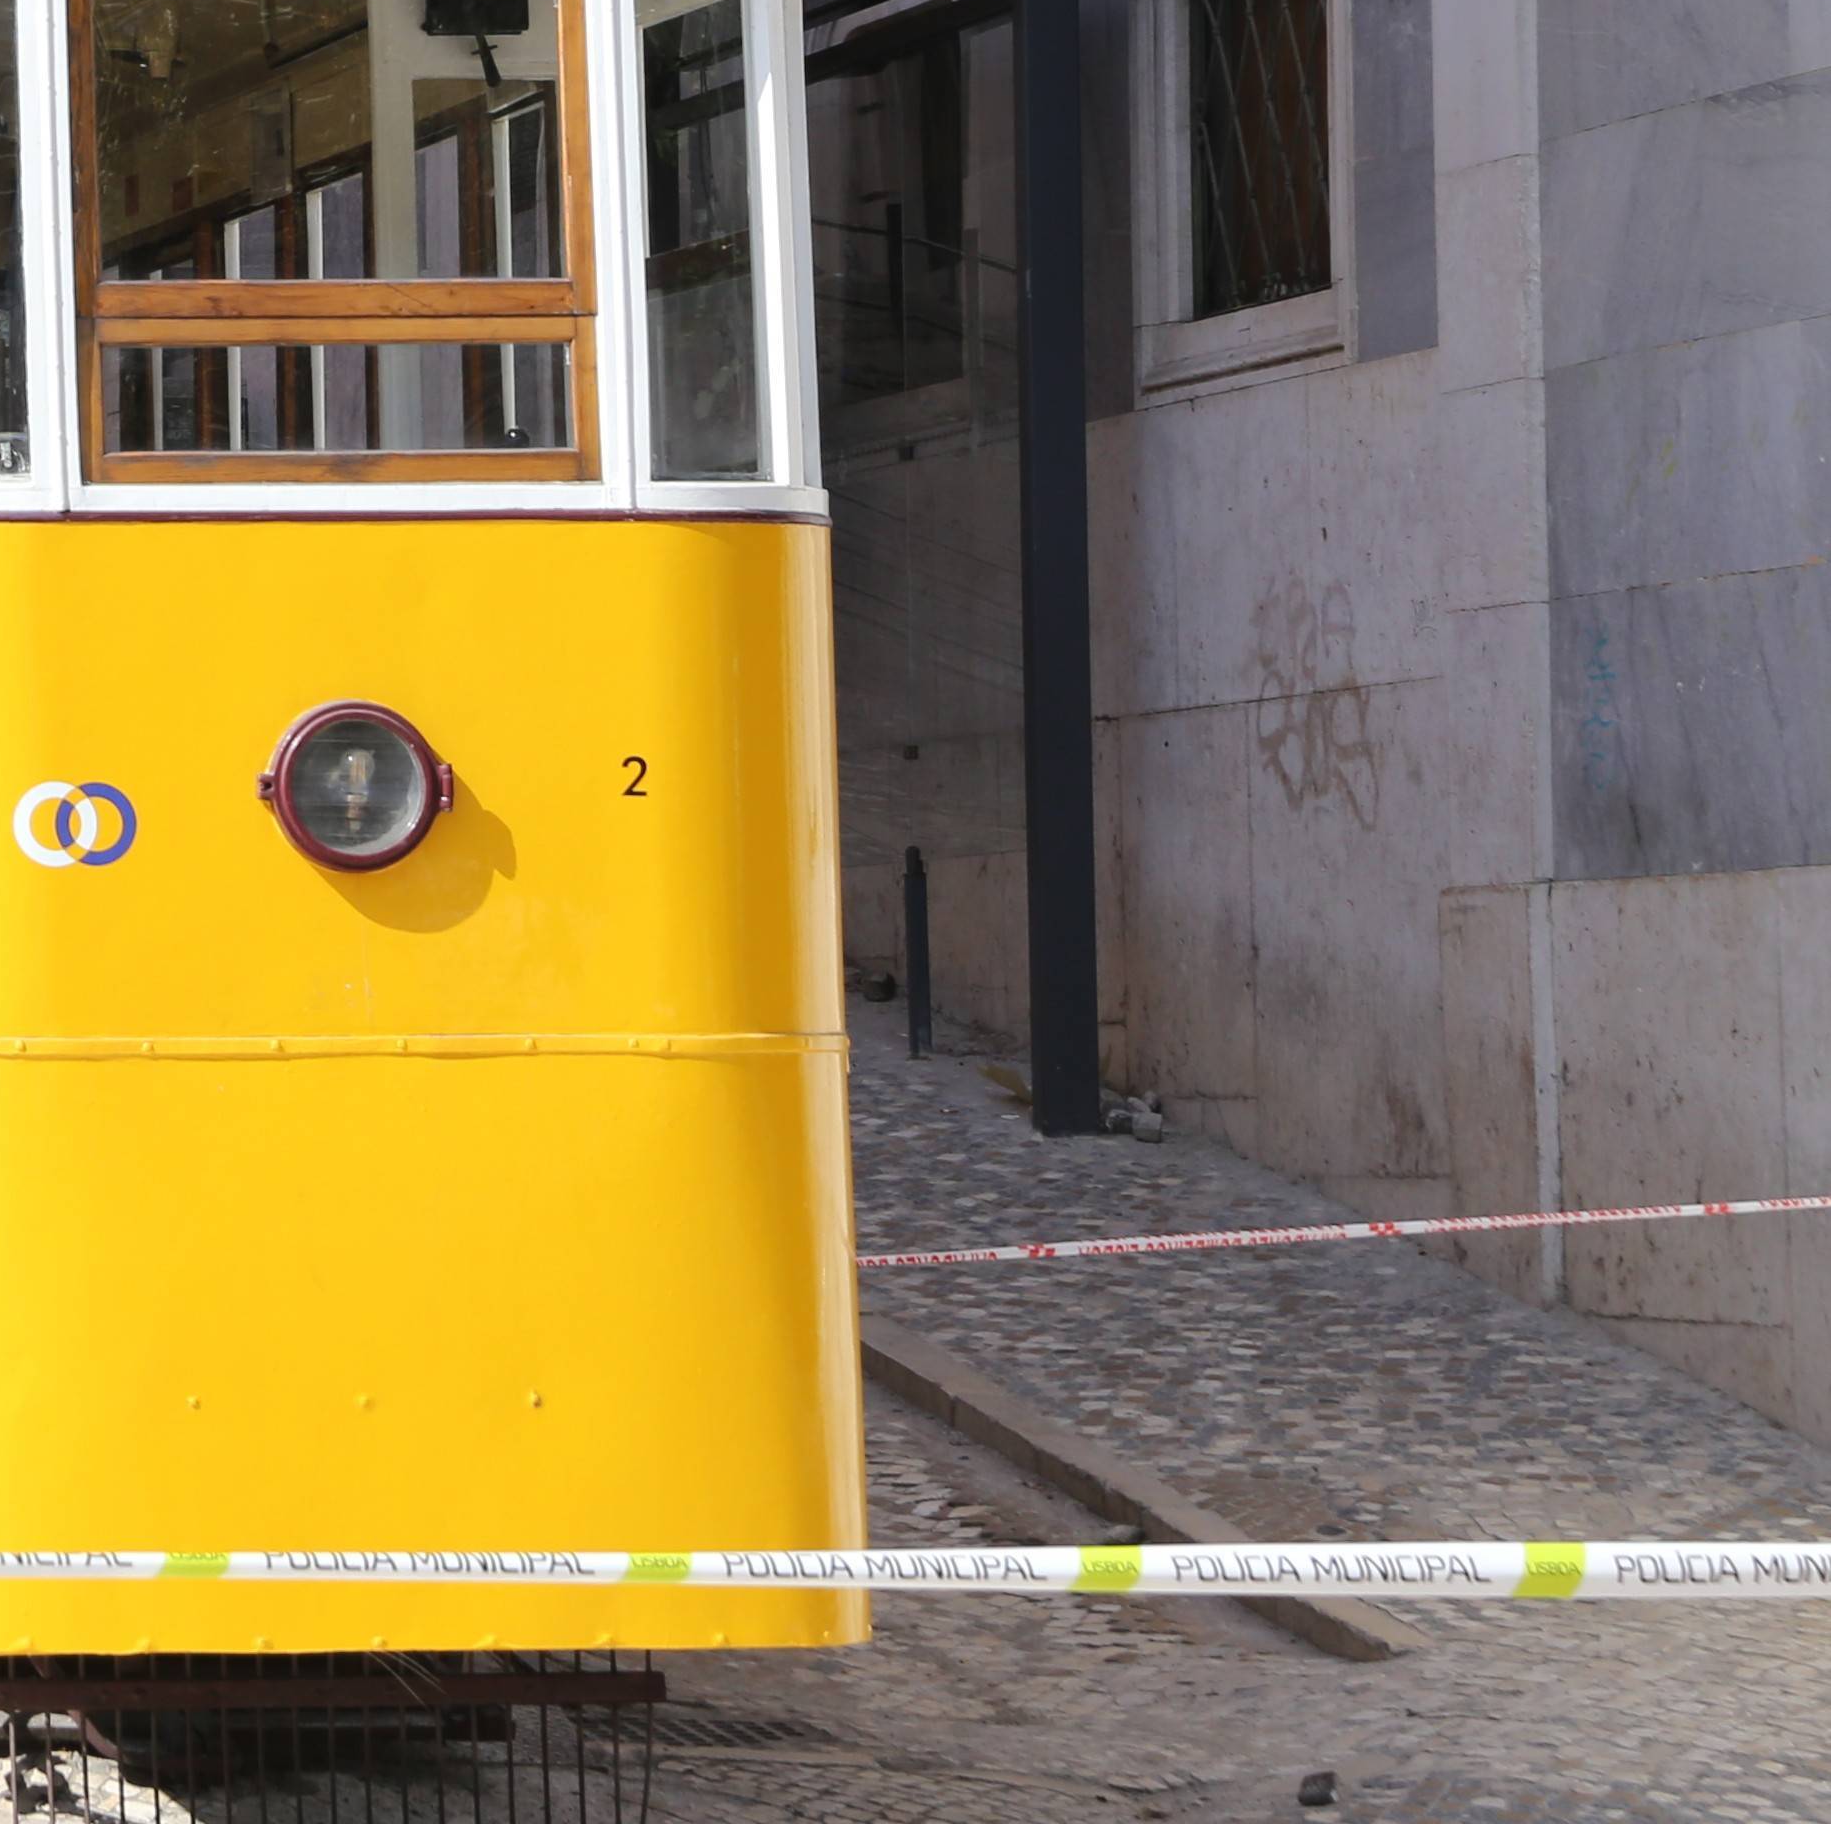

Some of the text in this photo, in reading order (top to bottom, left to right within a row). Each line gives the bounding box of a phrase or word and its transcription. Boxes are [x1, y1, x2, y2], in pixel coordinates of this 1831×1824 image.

[621, 755, 647, 796] 2
[411, 1552, 596, 1575] MUNICIPAL
[721, 1550, 1048, 1582] POLÍCIA MUNICIPAL
[1082, 1559, 1139, 1576] LISBOA
[1170, 1551, 1492, 1585] POLÍCIA MUNICIPAL
[1526, 1560, 1583, 1577] LISBOA
[1613, 1550, 1742, 1584] POLÍCIA
